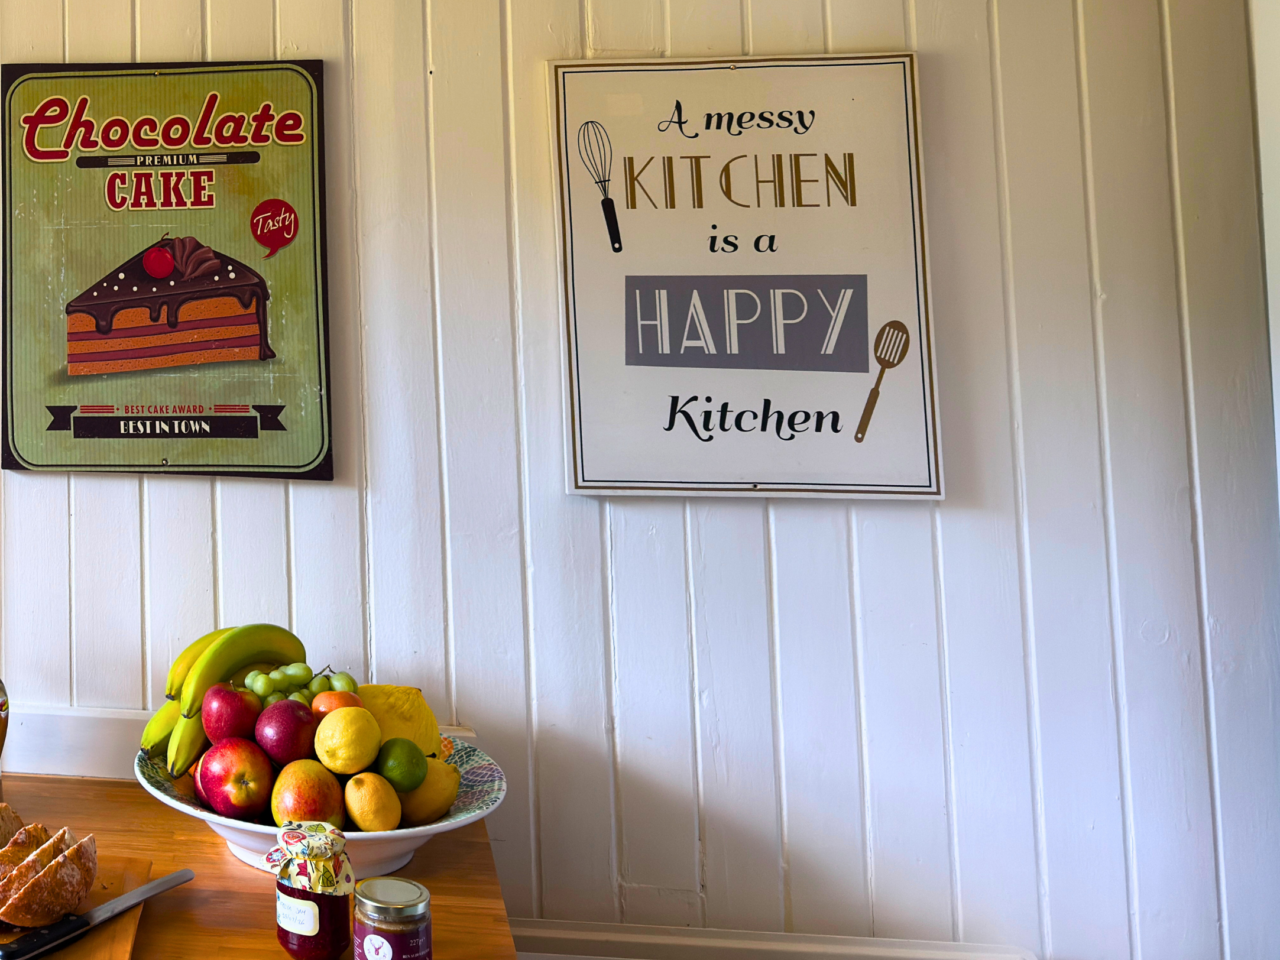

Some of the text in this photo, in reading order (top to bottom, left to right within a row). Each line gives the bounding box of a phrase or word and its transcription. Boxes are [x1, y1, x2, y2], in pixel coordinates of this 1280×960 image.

[19, 91, 307, 163] Chocolate
[657, 99, 816, 139] A messy
[136, 154, 198, 166] PREMIUM
[105, 169, 216, 211] CAKE
[623, 152, 857, 210] KITCHEN
[252, 207, 295, 238] Tasty
[707, 223, 779, 254] is a
[635, 288, 854, 355] HAPPY
[120, 420, 211, 434] BEST IN TOWN
[124, 405, 204, 415] BEST CAKE AWARD
[662, 395, 844, 442] Kitchen
